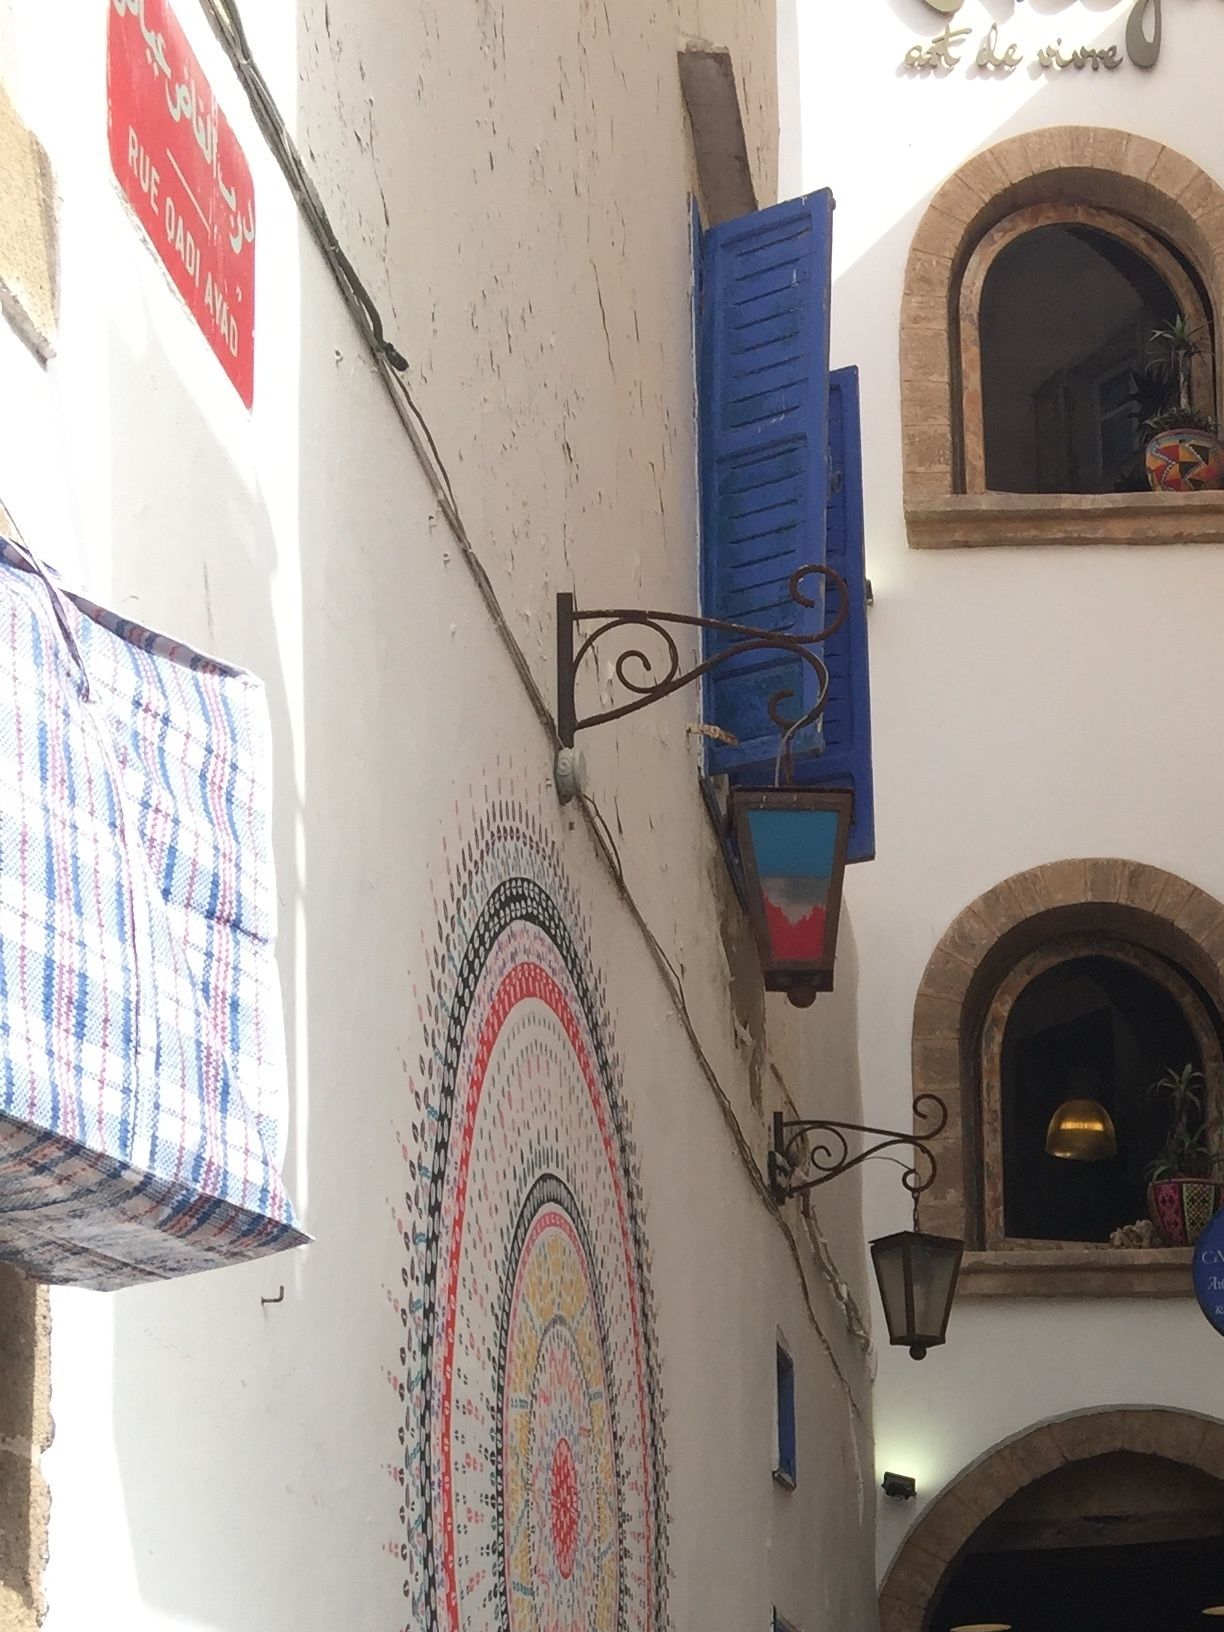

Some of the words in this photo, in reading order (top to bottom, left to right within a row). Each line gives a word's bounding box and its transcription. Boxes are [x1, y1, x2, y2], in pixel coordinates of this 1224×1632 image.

[904, 23, 972, 68] art
[975, 22, 1024, 67] de
[1036, 37, 1124, 71] vivre
[127, 125, 160, 215] RUE
[164, 196, 201, 286] QADI
[203, 272, 238, 357] AYAD
[1208, 1276, 1224, 1291] Art
